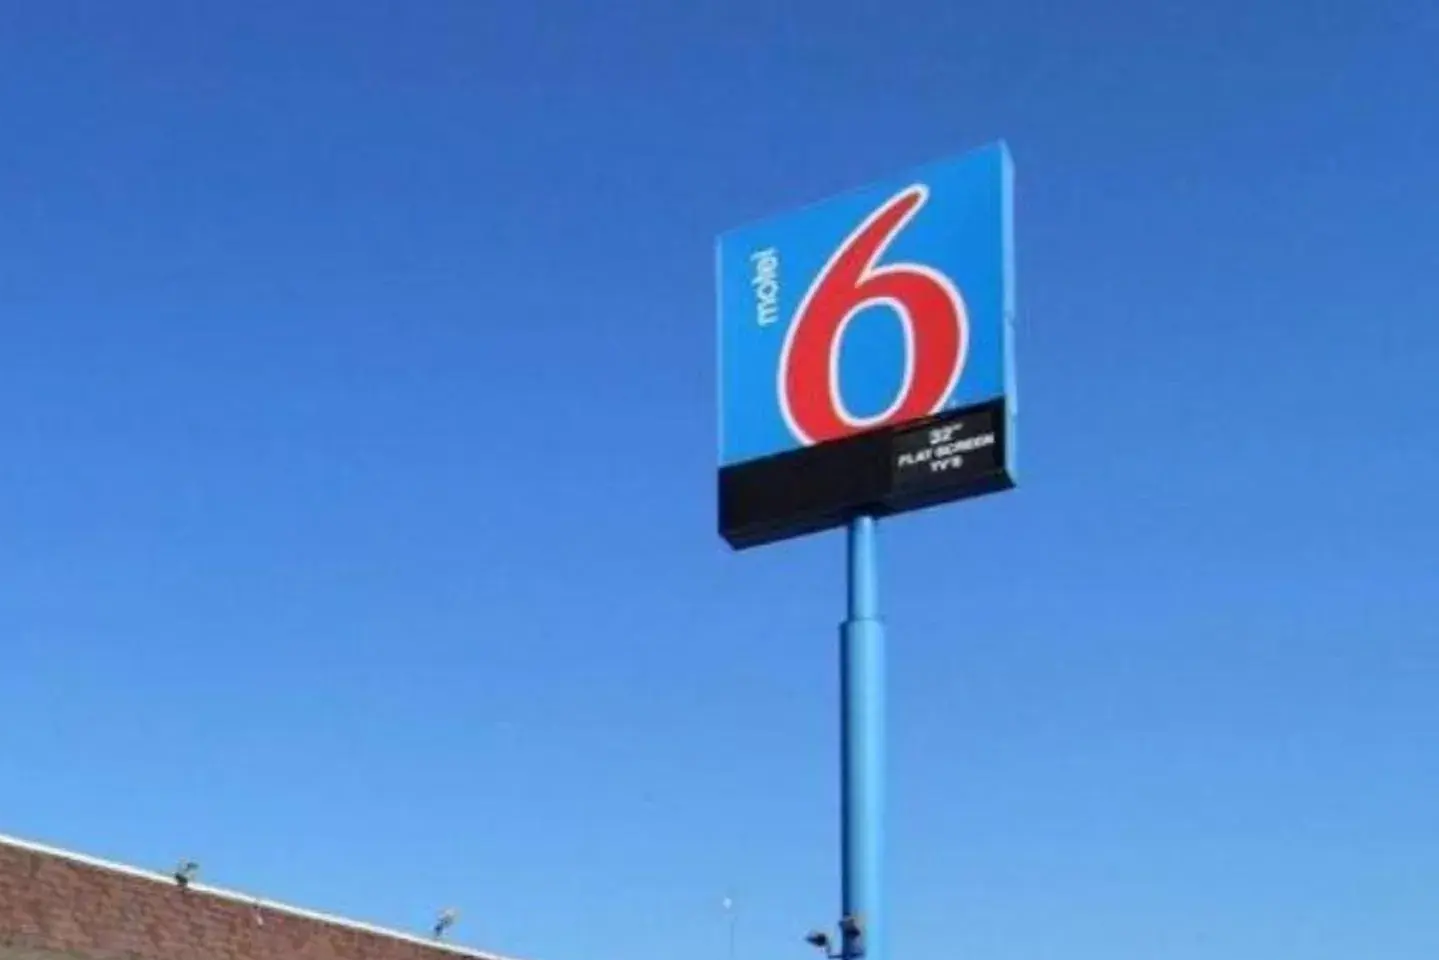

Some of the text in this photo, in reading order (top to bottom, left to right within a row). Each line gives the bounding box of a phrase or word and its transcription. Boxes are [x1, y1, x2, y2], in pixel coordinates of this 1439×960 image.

[750, 247, 779, 326] motel
[776, 183, 970, 445] 6
[898, 432, 995, 467] FLAT SCREEN
